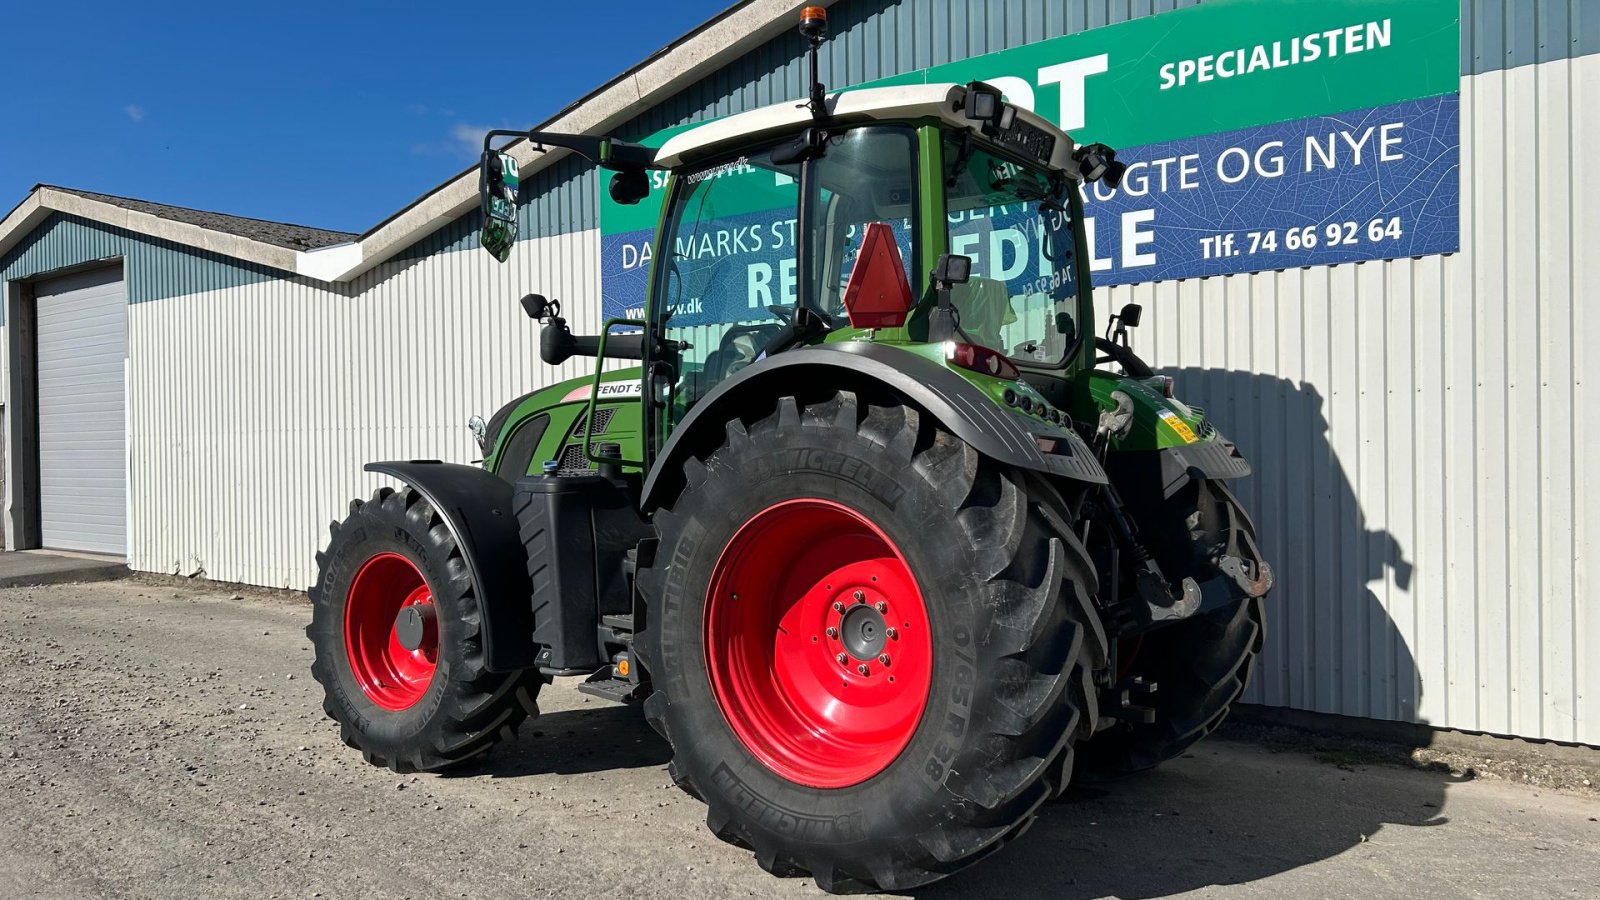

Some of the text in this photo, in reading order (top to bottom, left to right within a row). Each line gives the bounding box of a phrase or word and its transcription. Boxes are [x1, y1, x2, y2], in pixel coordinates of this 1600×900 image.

[1159, 18, 1391, 90] SPECIALISTEN
[1077, 122, 1405, 204] UGTE OG NYE
[621, 224, 763, 270] DAMARKS
[1199, 216, 1403, 260] Tlf. 74 66 92 64
[775, 449, 905, 506] MICHELIN
[924, 740, 951, 783] 38
